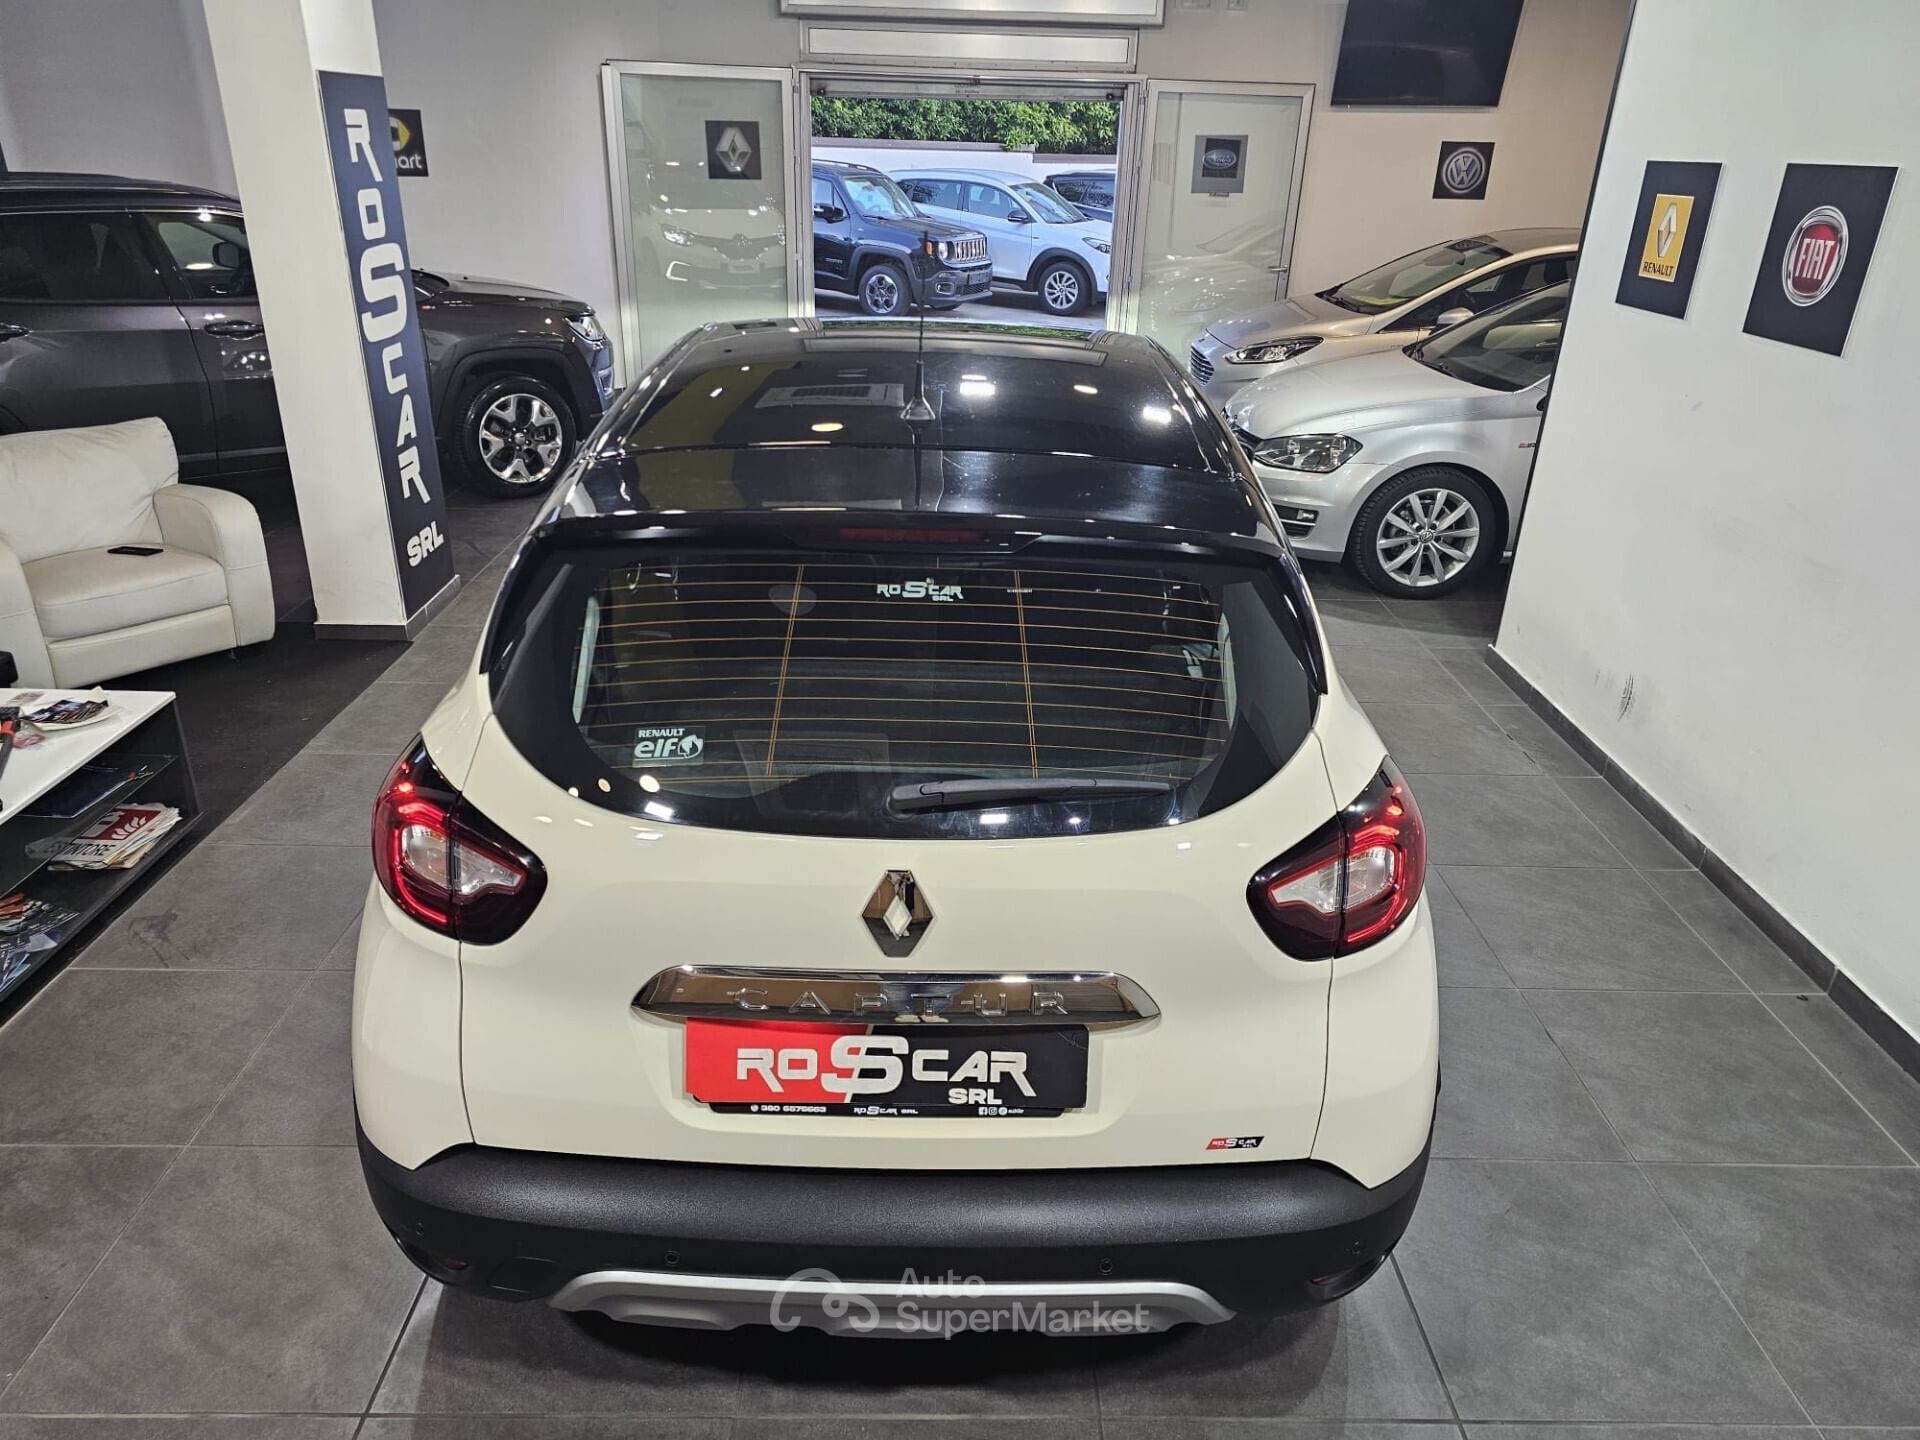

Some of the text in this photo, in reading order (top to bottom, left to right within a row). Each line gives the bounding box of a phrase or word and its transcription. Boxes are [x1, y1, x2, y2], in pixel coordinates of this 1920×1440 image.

[1642, 261, 1675, 277] RENAULT
[1795, 237, 1836, 281] FIAT
[407, 520, 445, 567] SRL
[638, 728, 685, 738] RENAULT
[634, 738, 679, 758] elf
[731, 987, 1069, 1016] CAPTUR
[948, 1088, 1003, 1105] SRL
